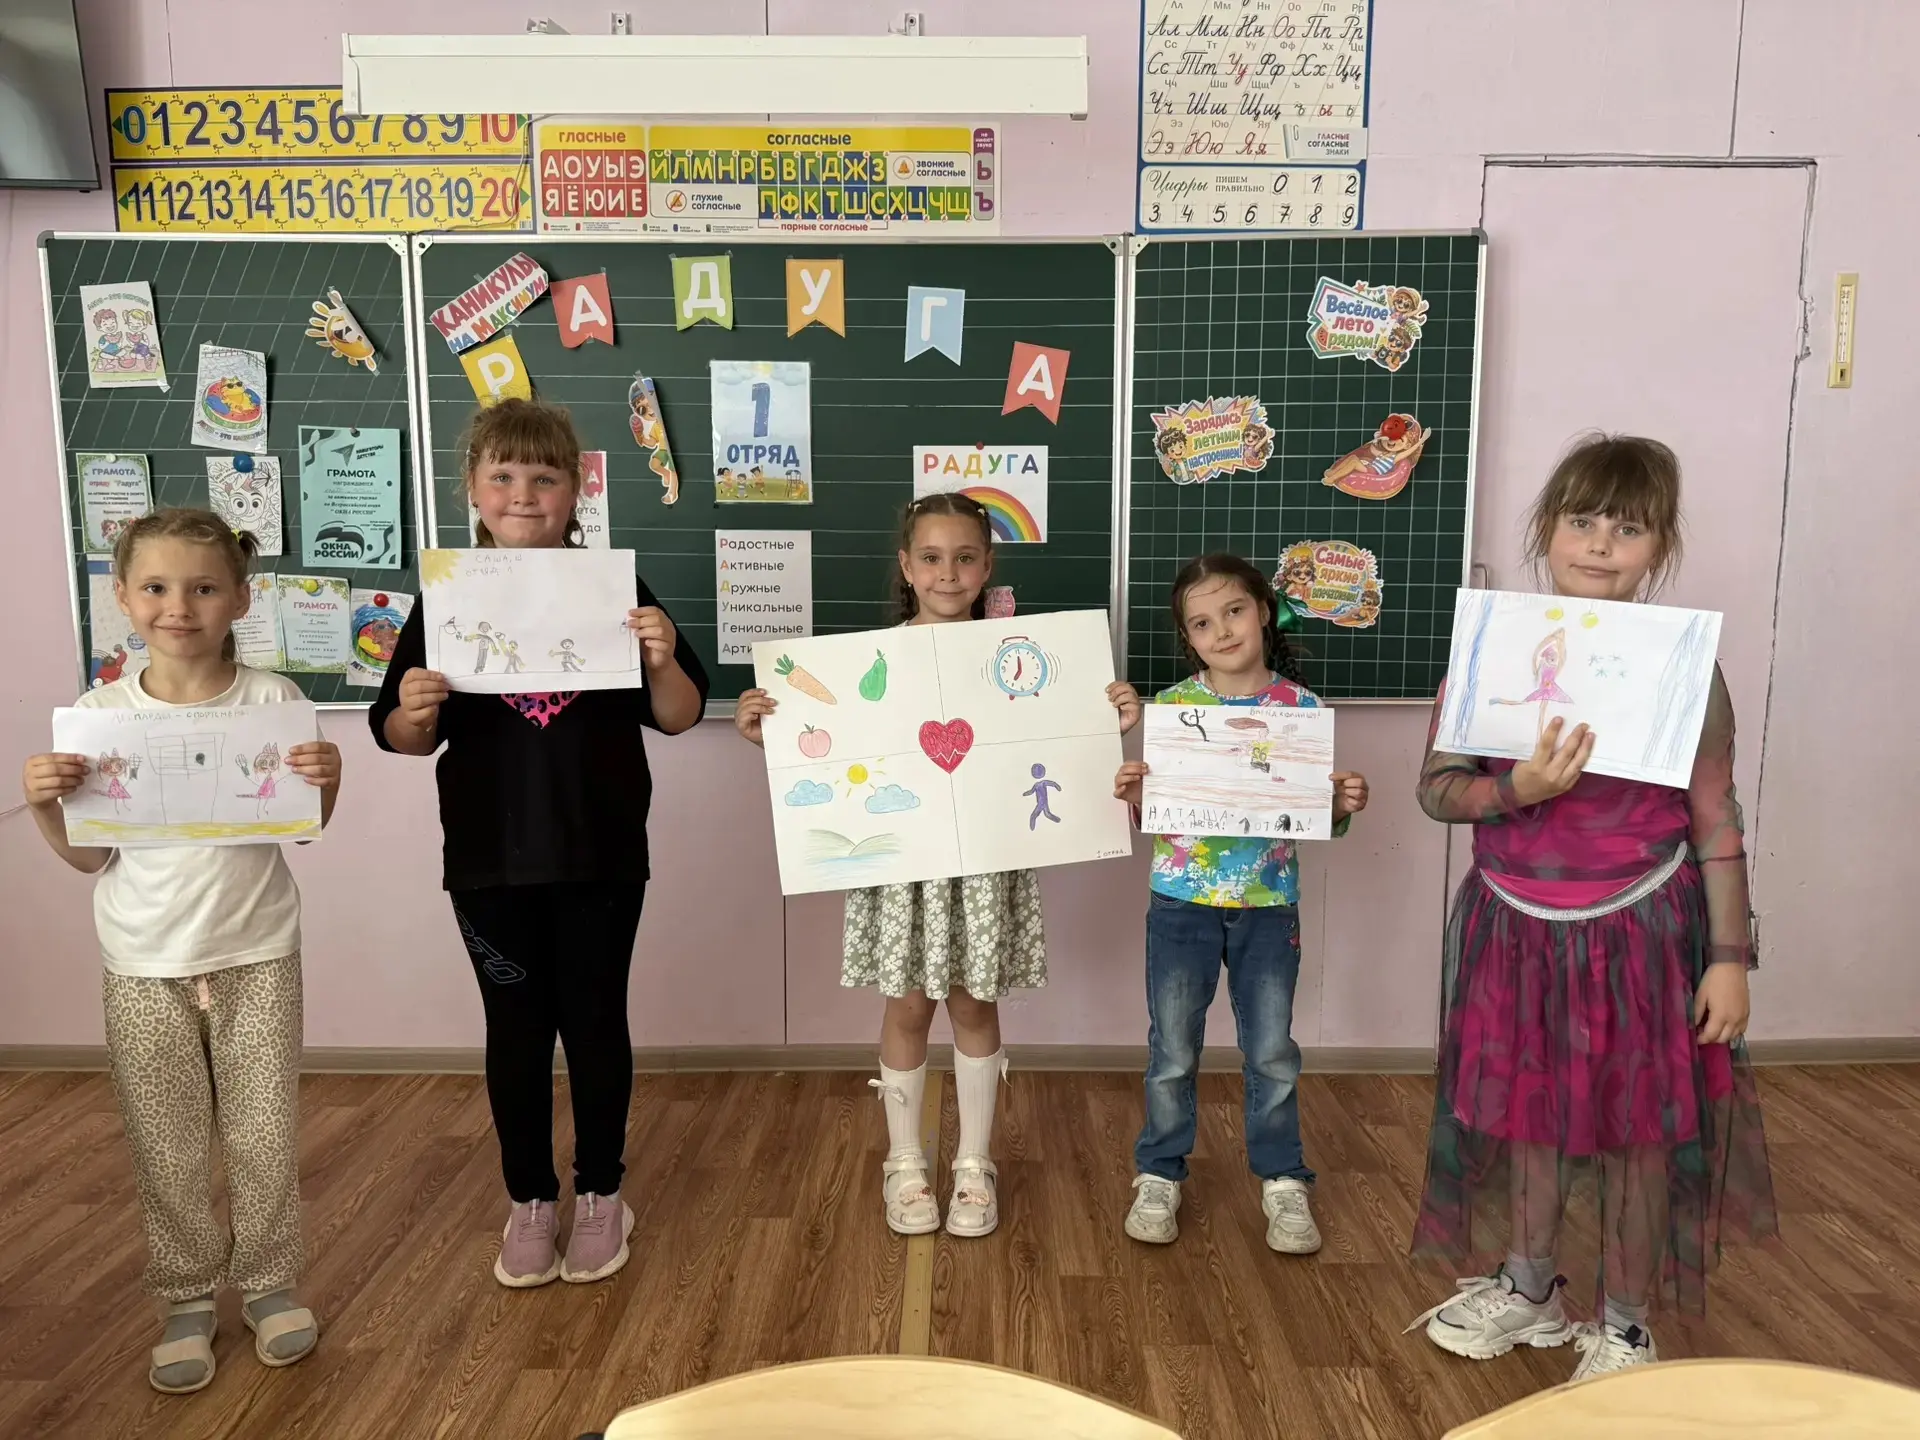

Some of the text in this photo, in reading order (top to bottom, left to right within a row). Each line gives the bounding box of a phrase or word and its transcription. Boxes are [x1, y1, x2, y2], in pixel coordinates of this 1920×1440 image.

[122, 105, 147, 145] 0
[152, 102, 170, 146] 1
[183, 101, 211, 146] 2
[219, 100, 246, 145] 3
[255, 100, 284, 144] 4
[293, 99, 319, 145] 5
[329, 99, 356, 144] 6
[558, 130, 626, 144] гласные
[767, 132, 852, 146] согласные
[1307, 140, 1350, 148] СОГЛАСНЫЕ
[1325, 148, 1349, 156] ЗНАКИ
[916, 160, 954, 169] звонкие
[916, 168, 966, 178] согласные
[1215, 176, 1248, 184] ПИШЕМ
[1145, 169, 1209, 202] Цифры
[1215, 184, 1265, 193] ПРАВИЛЬНО
[1273, 174, 1357, 194] 0 1 2
[128, 176, 520, 222] 11 12 13 14 15 16 17 18 19 20
[691, 194, 724, 202] глухие
[691, 202, 742, 211] согласные
[1148, 204, 1354, 224] 3 4 5 6 7 8 9
[780, 223, 868, 232] парные согласные
[430, 253, 540, 338] КАНИКУЛЫ
[449, 272, 548, 353] НА МАКСИМУМ!
[1326, 294, 1389, 322] Весёлое
[1332, 316, 1375, 334] лето
[1328, 332, 1380, 350] рядом!
[751, 382, 771, 438] 1
[1184, 412, 1242, 435] Зарядись
[1193, 429, 1241, 451] летним
[726, 444, 800, 468] ОТРЯД
[1188, 443, 1243, 470] настроением!
[92, 468, 136, 476] ГРАМОТА
[327, 469, 376, 478] ГРАМОТА
[923, 453, 1039, 480] РАДУГА
[321, 542, 352, 551] ОКНА
[720, 538, 796, 552] Радостные
[314, 550, 359, 559] РОССИИ
[1315, 546, 1366, 572] Самые
[720, 560, 785, 572] Активные
[1320, 568, 1360, 585] яркие
[720, 580, 782, 595] Дружные
[294, 602, 338, 610] ГРАМОТА
[722, 600, 804, 613] Уникальные
[722, 622, 804, 634] Гениальные
[722, 643, 753, 656] Арти
